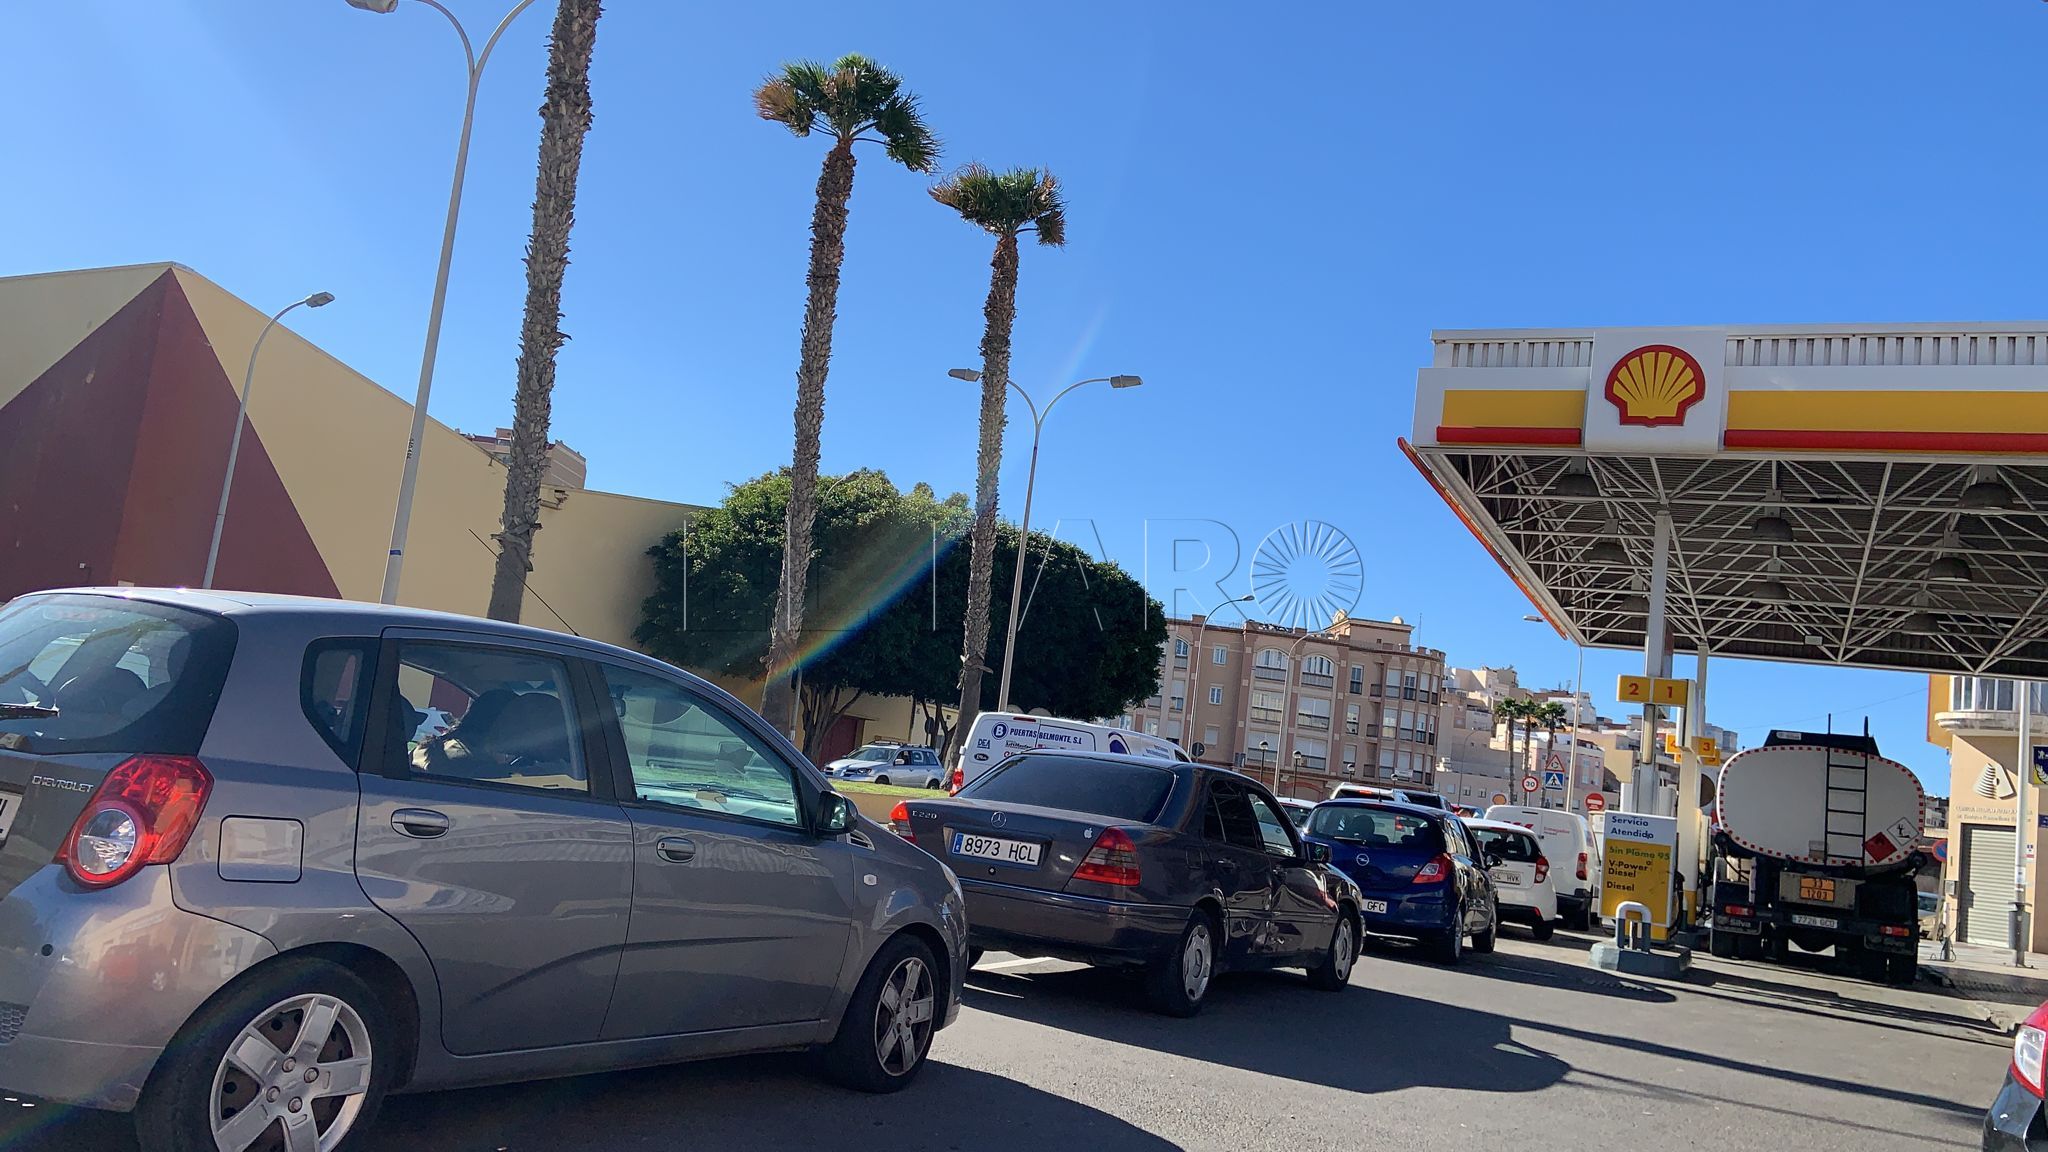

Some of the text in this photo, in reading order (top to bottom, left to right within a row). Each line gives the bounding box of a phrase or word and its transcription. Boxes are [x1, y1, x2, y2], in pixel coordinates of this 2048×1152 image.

[1628, 682, 1640, 696] 2
[1667, 686, 1673, 699] 1
[1009, 728, 1038, 738] PUERTAS
[1703, 742, 1711, 751] 3
[31, 775, 94, 793] CHEVROLET
[1525, 780, 1535, 788] 30
[1611, 815, 1649, 827] Servicio
[964, 837, 1036, 862] 8973 HCL
[1609, 846, 1624, 855] Sin
[1657, 852, 1671, 860] 95
[1609, 860, 1649, 871] V-Power
[1608, 868, 1636, 878] Diesel
[1606, 881, 1635, 892] Diesel
[1367, 901, 1385, 912] GFC
